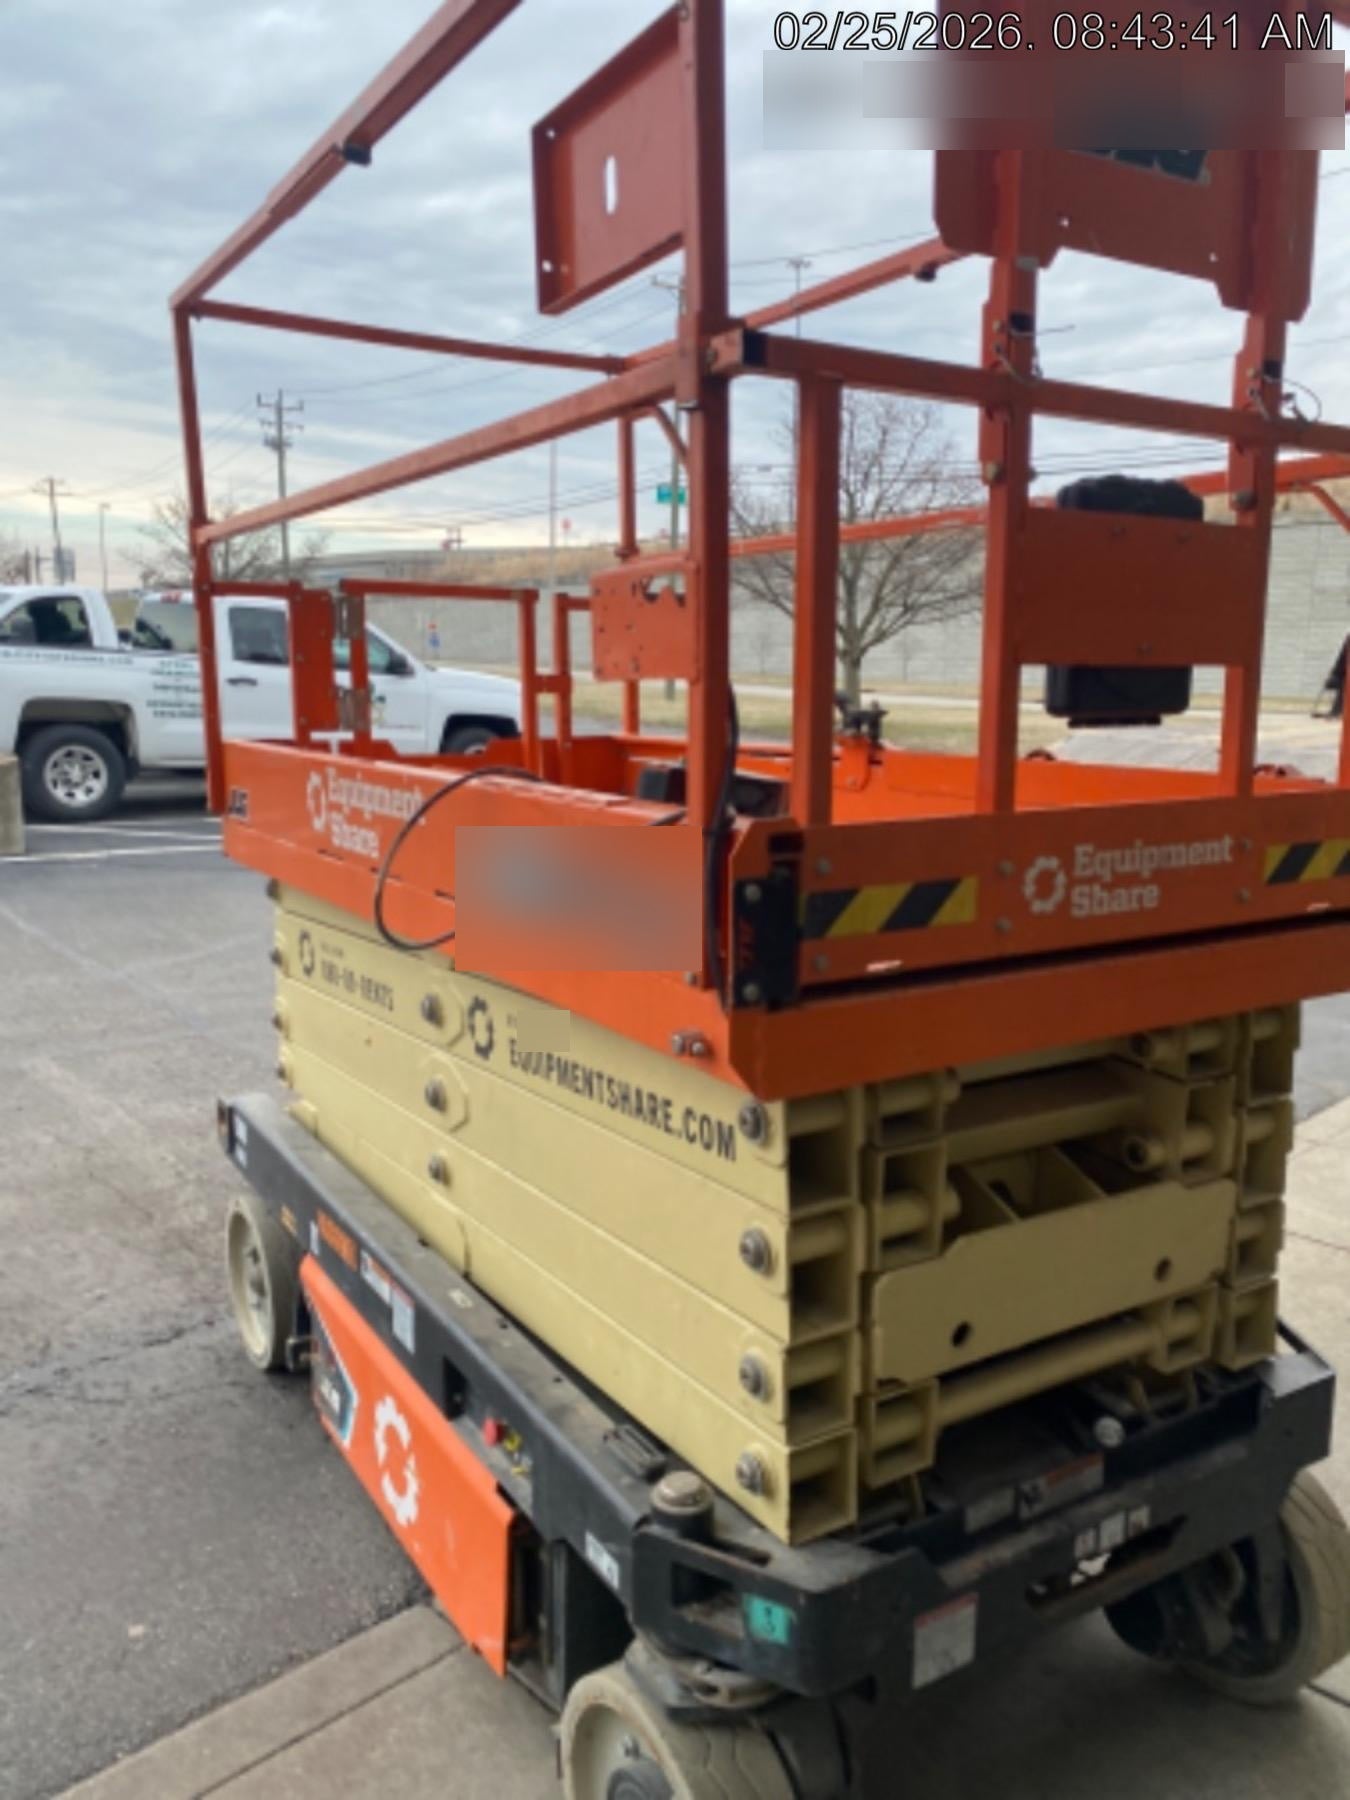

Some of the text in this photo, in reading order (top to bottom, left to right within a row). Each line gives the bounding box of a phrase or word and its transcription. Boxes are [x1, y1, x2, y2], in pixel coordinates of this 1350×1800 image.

[330, 811, 380, 859] Share
[1072, 833, 1234, 882] Equipment
[1070, 883, 1160, 918] Share
